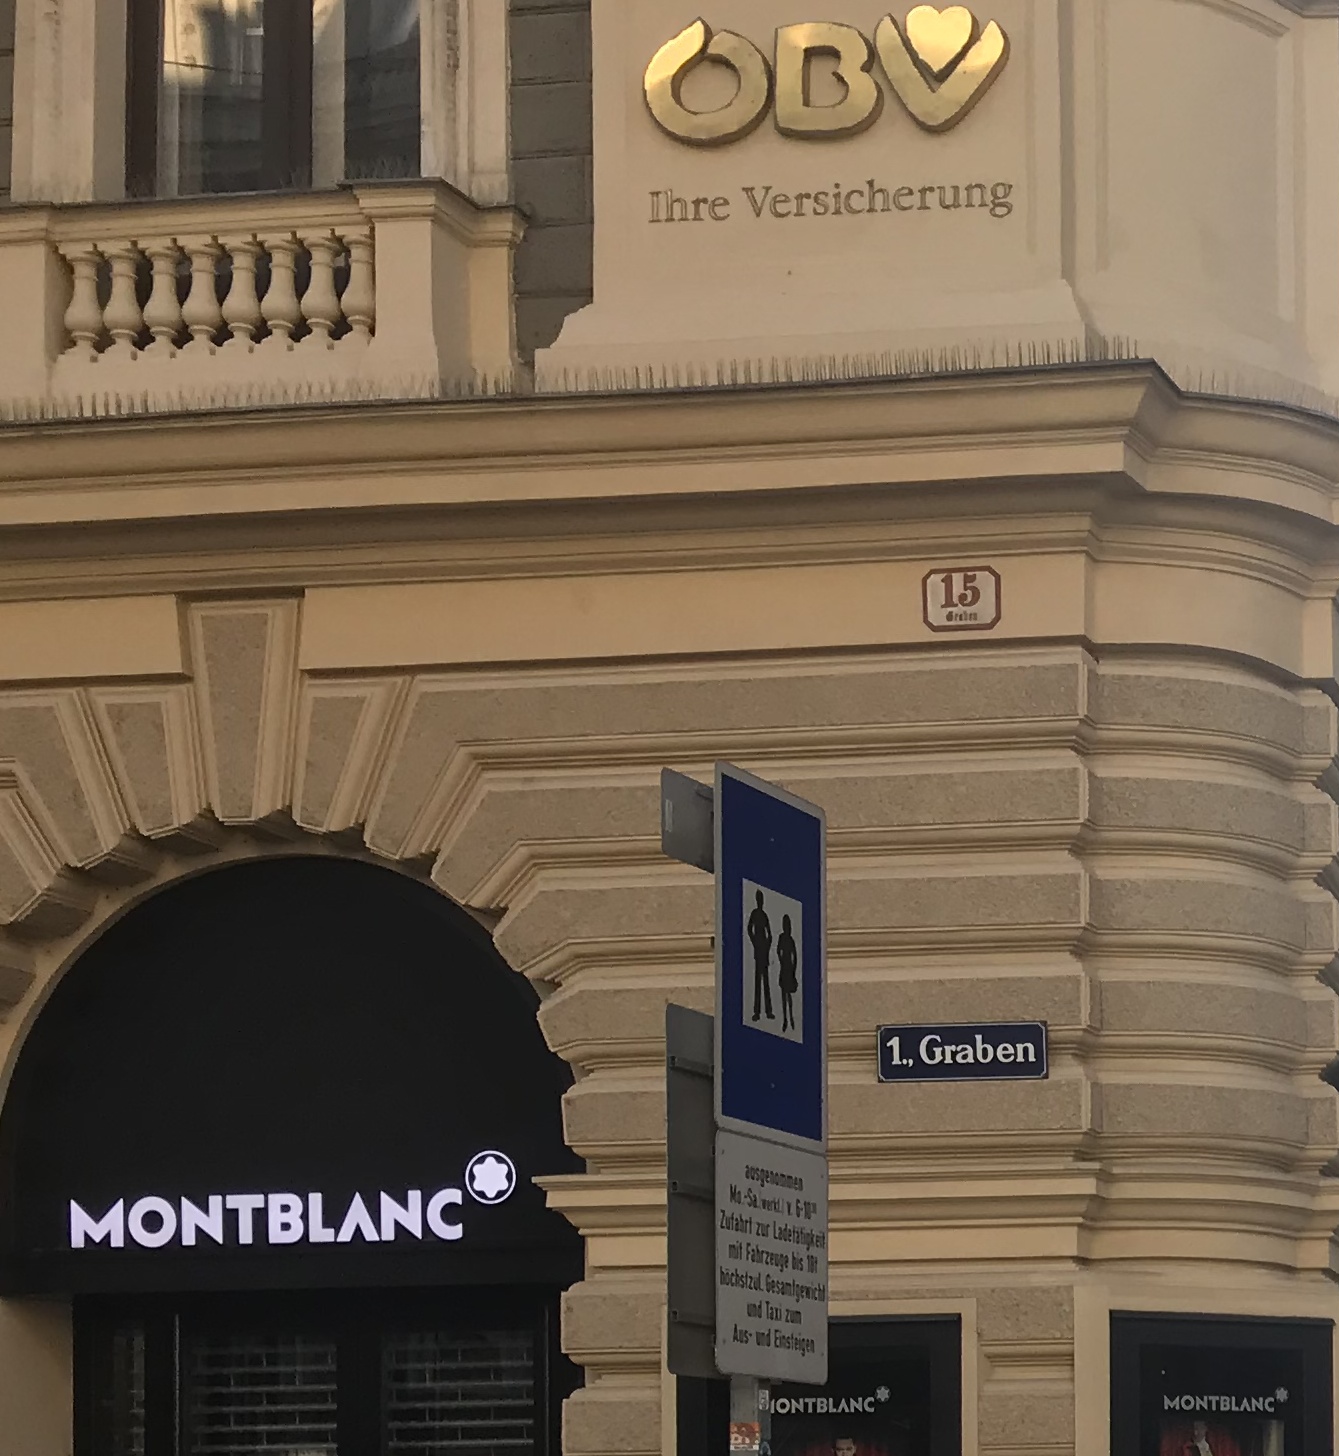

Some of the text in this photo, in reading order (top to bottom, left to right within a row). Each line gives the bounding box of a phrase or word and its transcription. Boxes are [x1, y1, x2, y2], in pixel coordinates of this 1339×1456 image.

[648, 178, 1013, 223] Ihre Versicherung
[941, 572, 981, 609] 15
[919, 1034, 1037, 1065] Graben
[745, 1164, 804, 1191] ausgenommen
[70, 1188, 463, 1249] MONTBLANC
[720, 1208, 753, 1234] Zufahrt
[756, 1221, 770, 1238] zur
[728, 1240, 743, 1260] mit
[792, 1251, 804, 1272] bis
[747, 1300, 802, 1325] und Taxi zum
[755, 1328, 771, 1347] und
[1163, 1394, 1275, 1413] MONTBLANC
